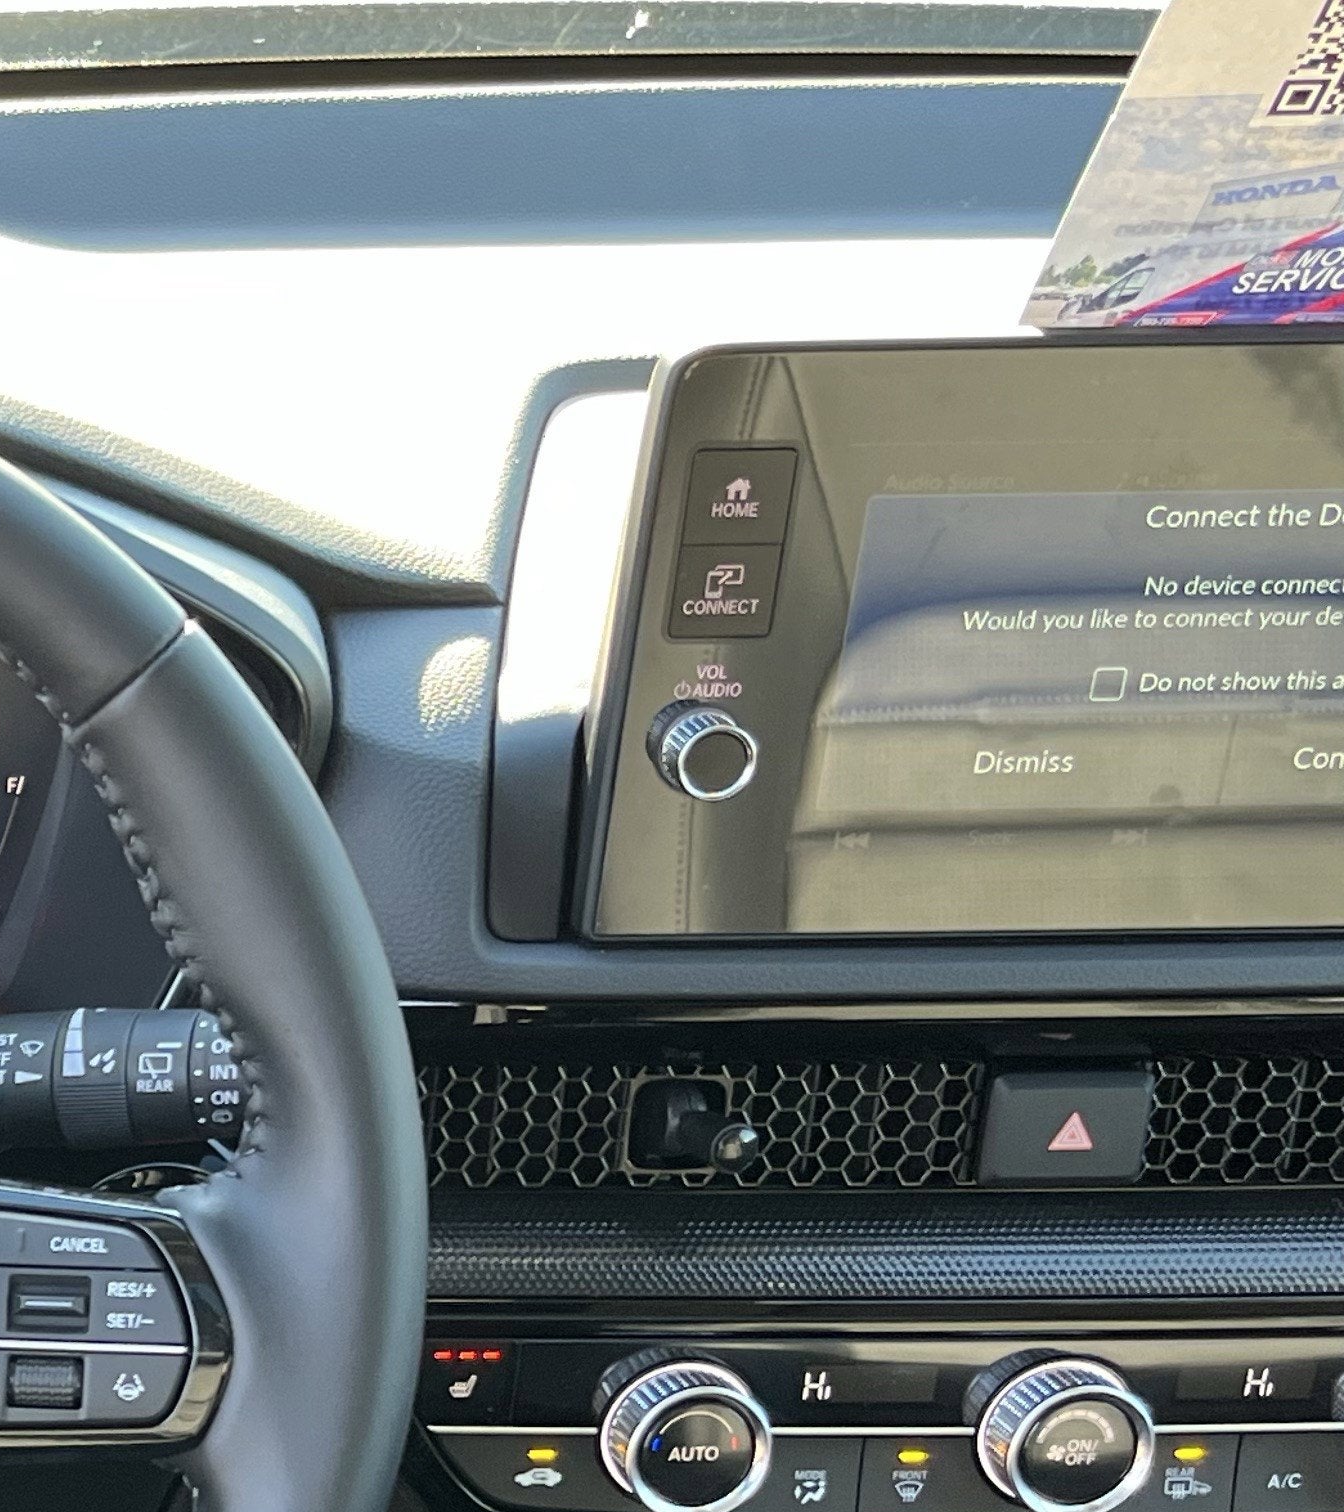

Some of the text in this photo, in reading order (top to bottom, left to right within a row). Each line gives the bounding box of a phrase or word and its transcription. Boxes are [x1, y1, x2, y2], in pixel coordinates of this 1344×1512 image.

[1212, 175, 1341, 207] HONDA
[1293, 247, 1344, 268] MO
[711, 502, 760, 518] HOME
[1146, 503, 1344, 528] Connect the D
[1144, 576, 1178, 596] No
[1184, 574, 1256, 596] device
[682, 599, 760, 616] CONNECT
[963, 609, 1036, 631] Would
[1043, 614, 1084, 633] you
[1089, 608, 1128, 629] like
[1134, 610, 1157, 629] to
[1163, 609, 1252, 628] connect
[1259, 610, 1311, 630] your
[696, 664, 728, 680] VOL
[1139, 673, 1173, 692] Do
[1178, 674, 1216, 691] not
[1221, 672, 1282, 691] show
[1286, 670, 1327, 690] this
[692, 682, 743, 698] AUDIO
[973, 750, 1074, 774] Dismiss
[136, 1080, 174, 1094] REAR
[210, 1090, 240, 1106] ON
[48, 1236, 109, 1254] CANCEL
[667, 1445, 720, 1463] AUTO
[1067, 1439, 1098, 1453] ON/
[1064, 1452, 1096, 1466] OFF
[795, 1470, 827, 1481] MODE
[892, 1470, 928, 1480] FRONT
[1165, 1467, 1196, 1478] REAR
[1268, 1472, 1303, 1489] A/C
